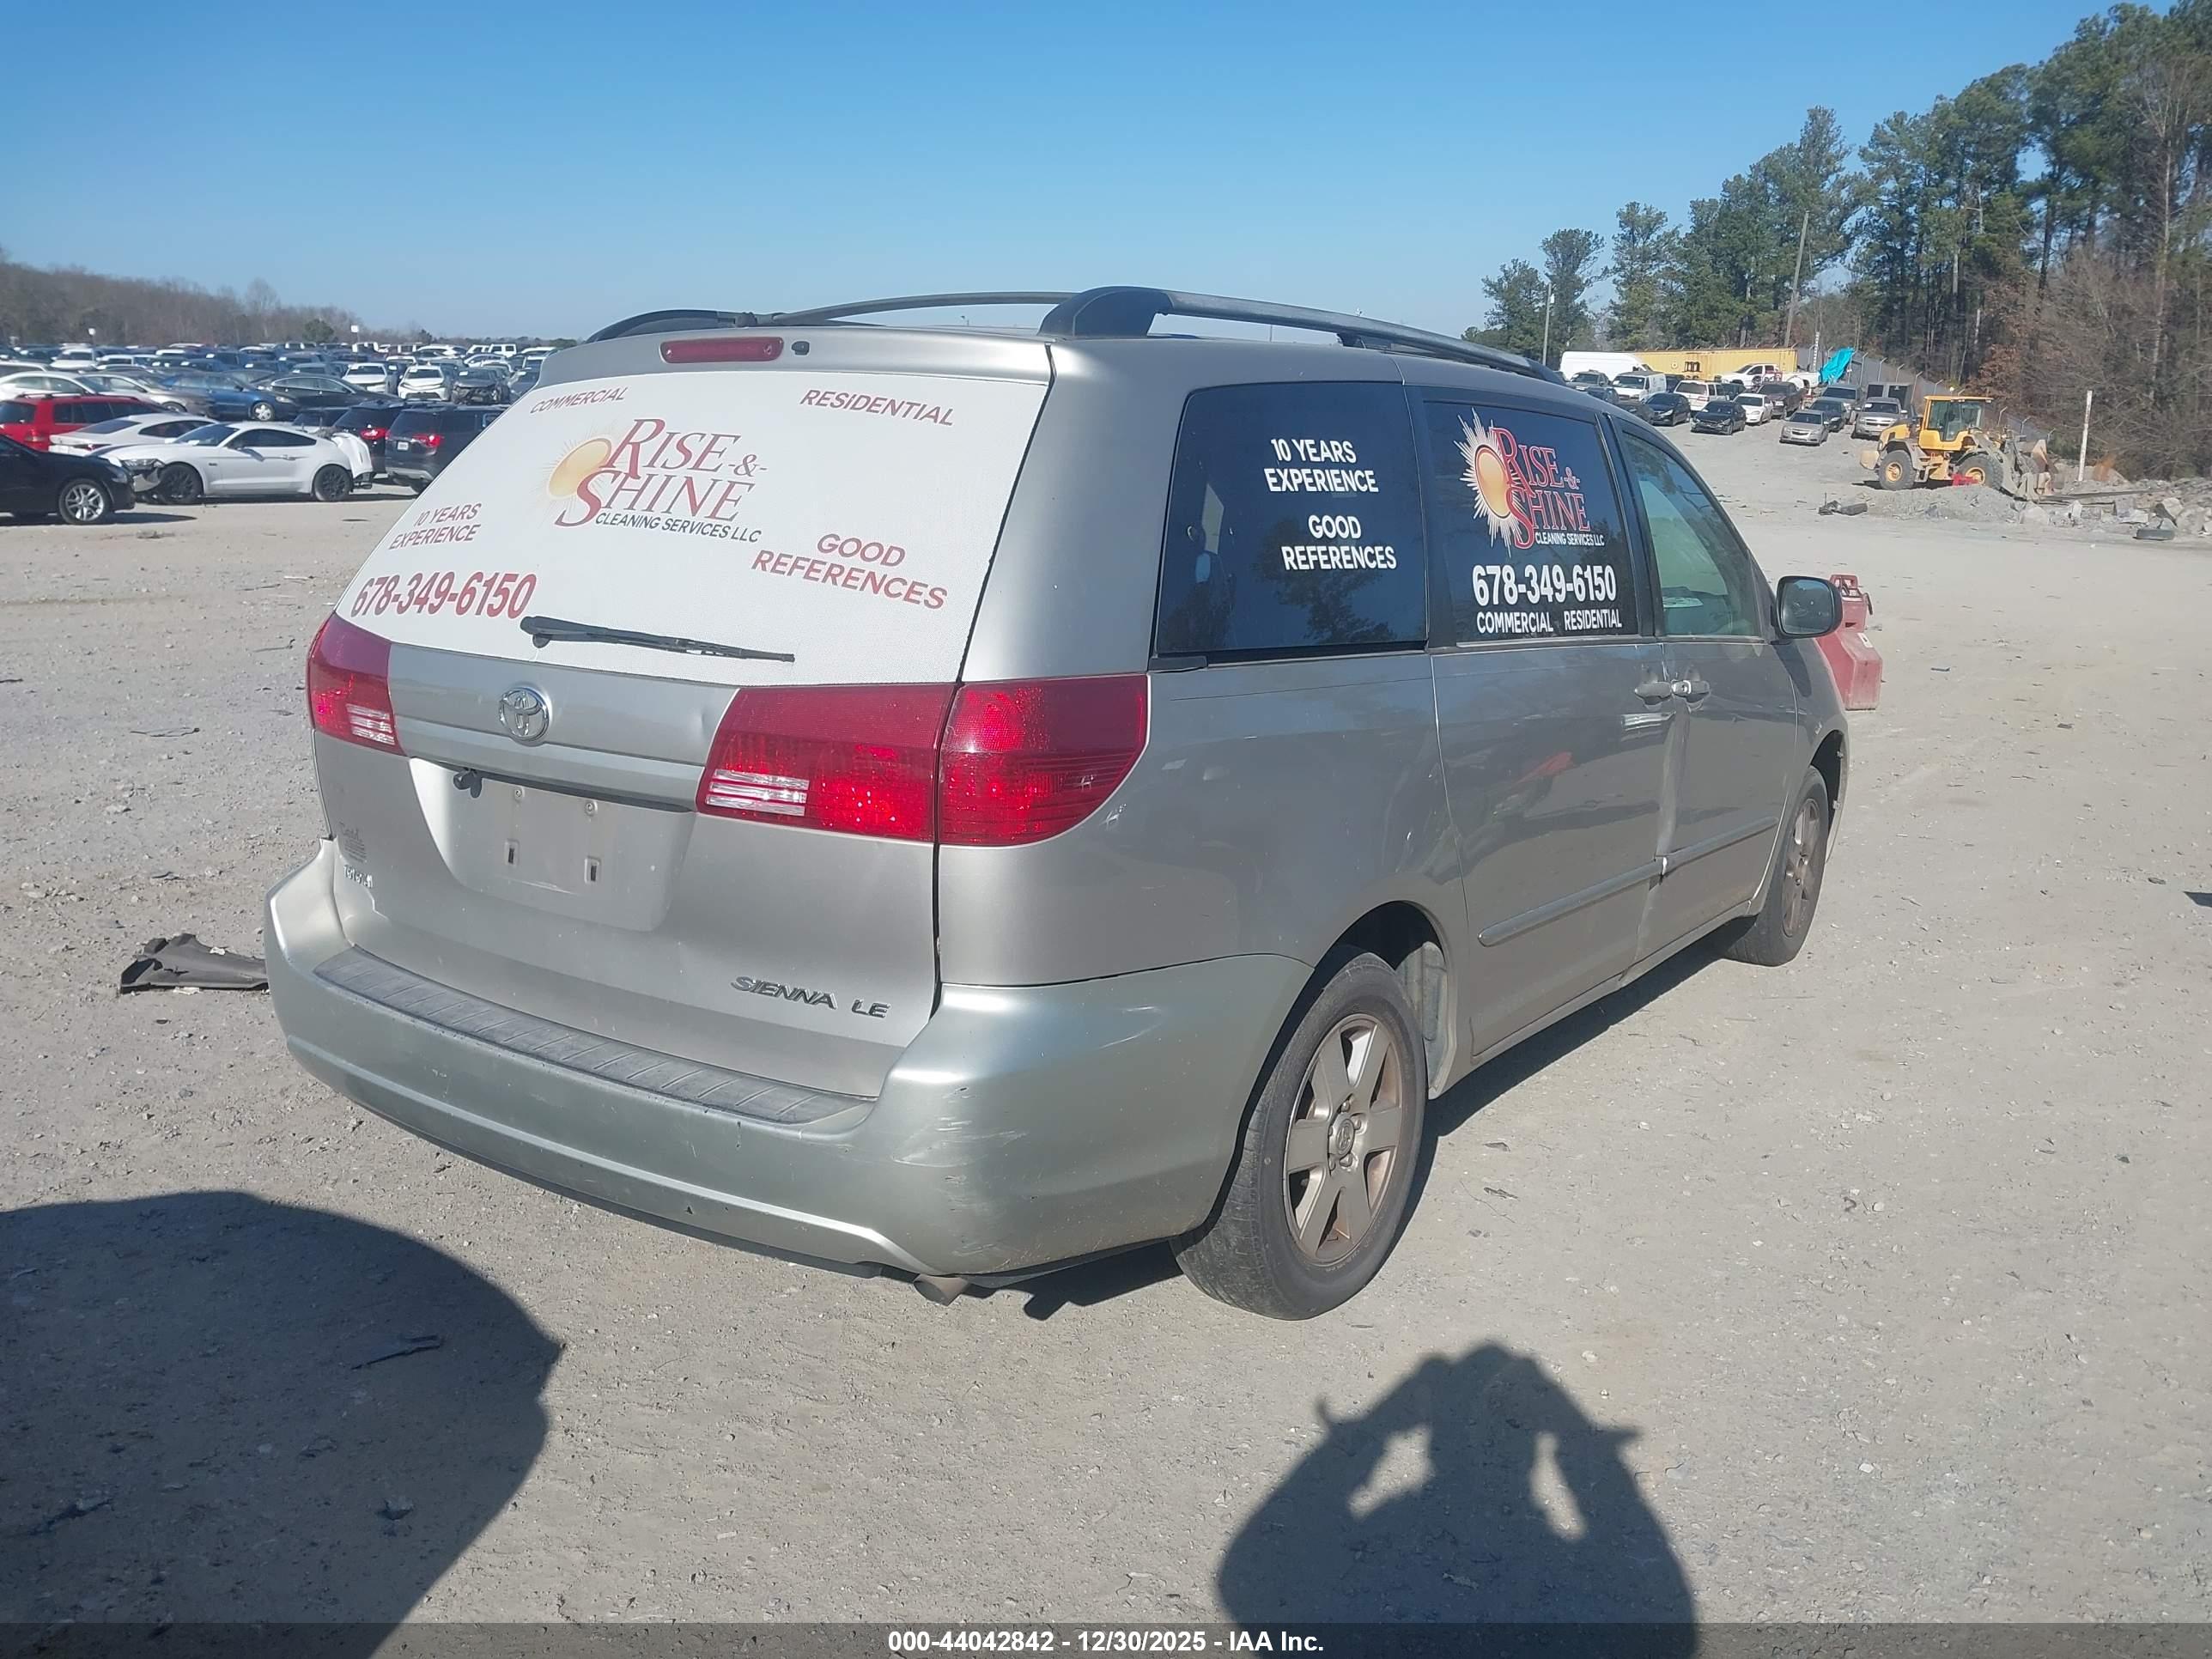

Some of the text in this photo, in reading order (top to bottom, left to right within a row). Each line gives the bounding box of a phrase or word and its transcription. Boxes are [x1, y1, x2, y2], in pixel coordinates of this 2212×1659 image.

[530, 386, 628, 414] COMMERCIAL
[800, 389, 955, 426] RESIDENTIAL
[599, 418, 741, 479] RISE
[1270, 439, 1357, 464] 10 YEARS
[1490, 427, 1564, 498] RISE
[1264, 468, 1379, 493] EXPERIENCE
[414, 503, 482, 526] 10 YEARS
[555, 470, 756, 527] SHINE
[595, 513, 762, 543] CLEANING SERVICES LLC
[1308, 514, 1361, 539] GOOD
[1505, 485, 1590, 550] SHINE
[388, 525, 481, 550] EXPERIENCE
[817, 533, 906, 567] GOOD
[1534, 532, 1605, 546] CLEANING SERVICES LLC
[1281, 545, 1396, 571] REFERENCES
[350, 572, 537, 619] 678-349-6150
[751, 550, 947, 610] REFERENCES
[1472, 563, 1617, 606] 678-349-6150
[1476, 609, 1622, 635] COMMERCIAL RESIDENTIAL
[731, 975, 890, 1018] SIENNA LE
